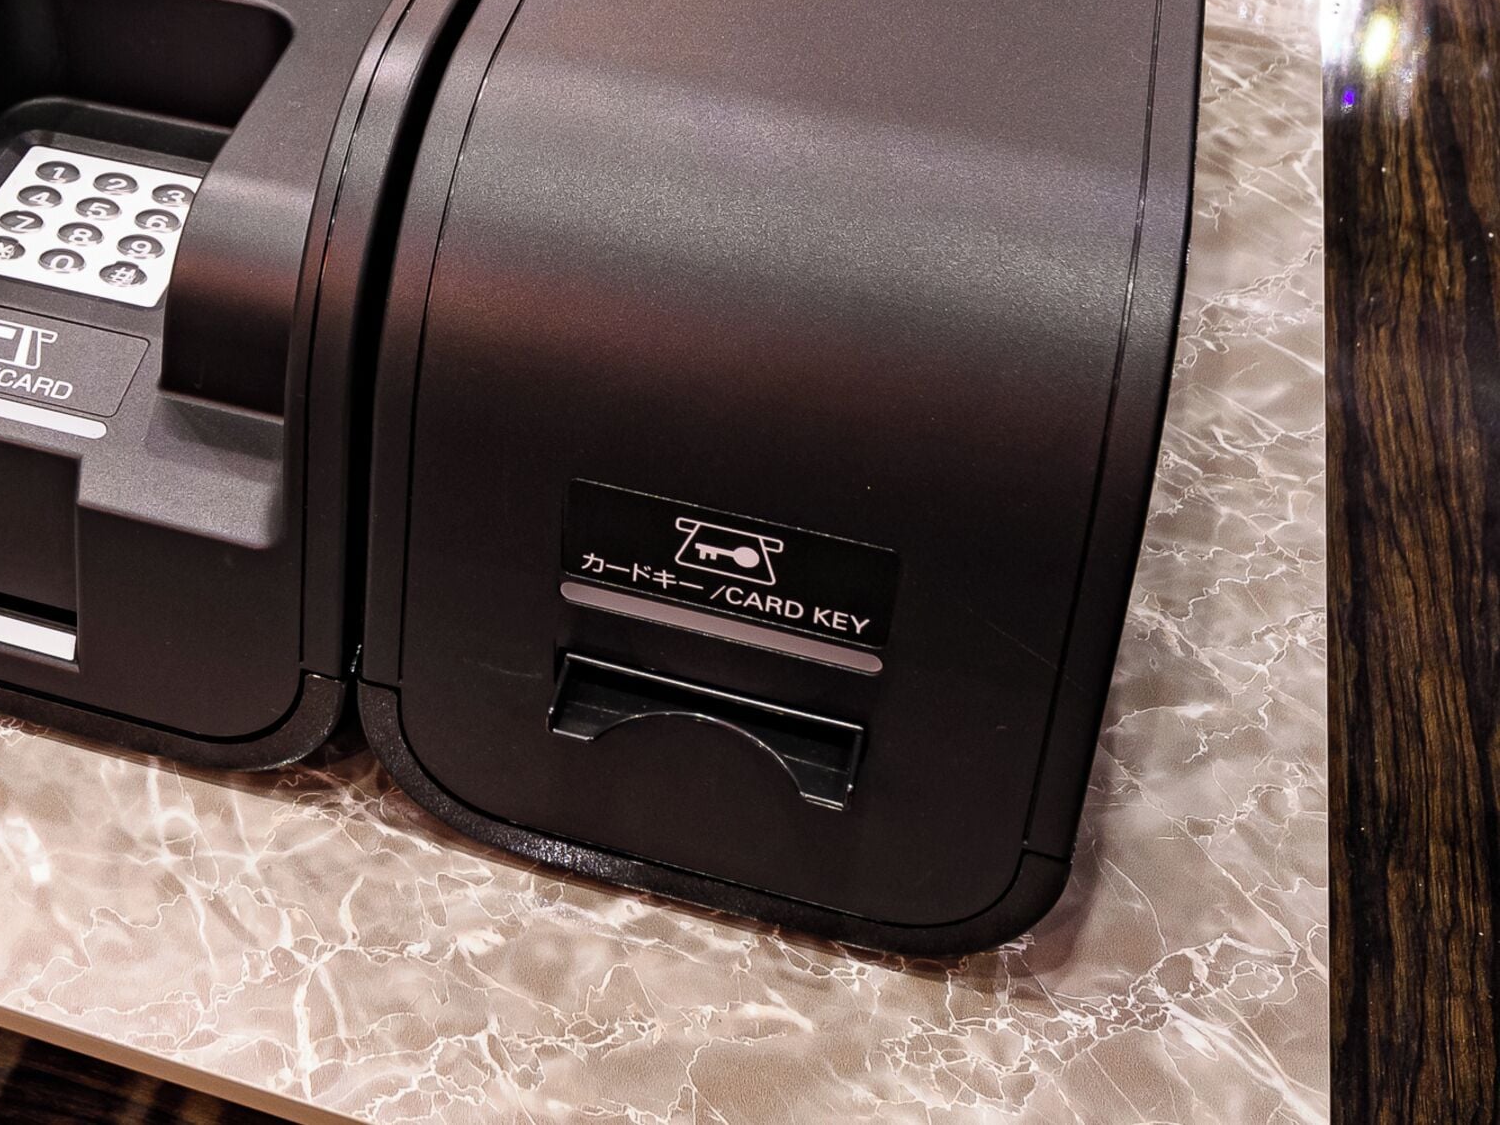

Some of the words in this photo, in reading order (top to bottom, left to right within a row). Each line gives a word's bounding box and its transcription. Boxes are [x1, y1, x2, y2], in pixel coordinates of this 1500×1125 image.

[53, 167, 66, 180] 1
[105, 178, 125, 190] 2
[166, 190, 186, 203] 3
[28, 191, 50, 204] 4
[86, 202, 111, 217] 5
[145, 214, 168, 229] 6
[14, 215, 35, 230] 7
[69, 228, 92, 242] 8
[130, 240, 152, 253] 9
[50, 254, 74, 271] 0
[813, 606, 870, 635] KEY
